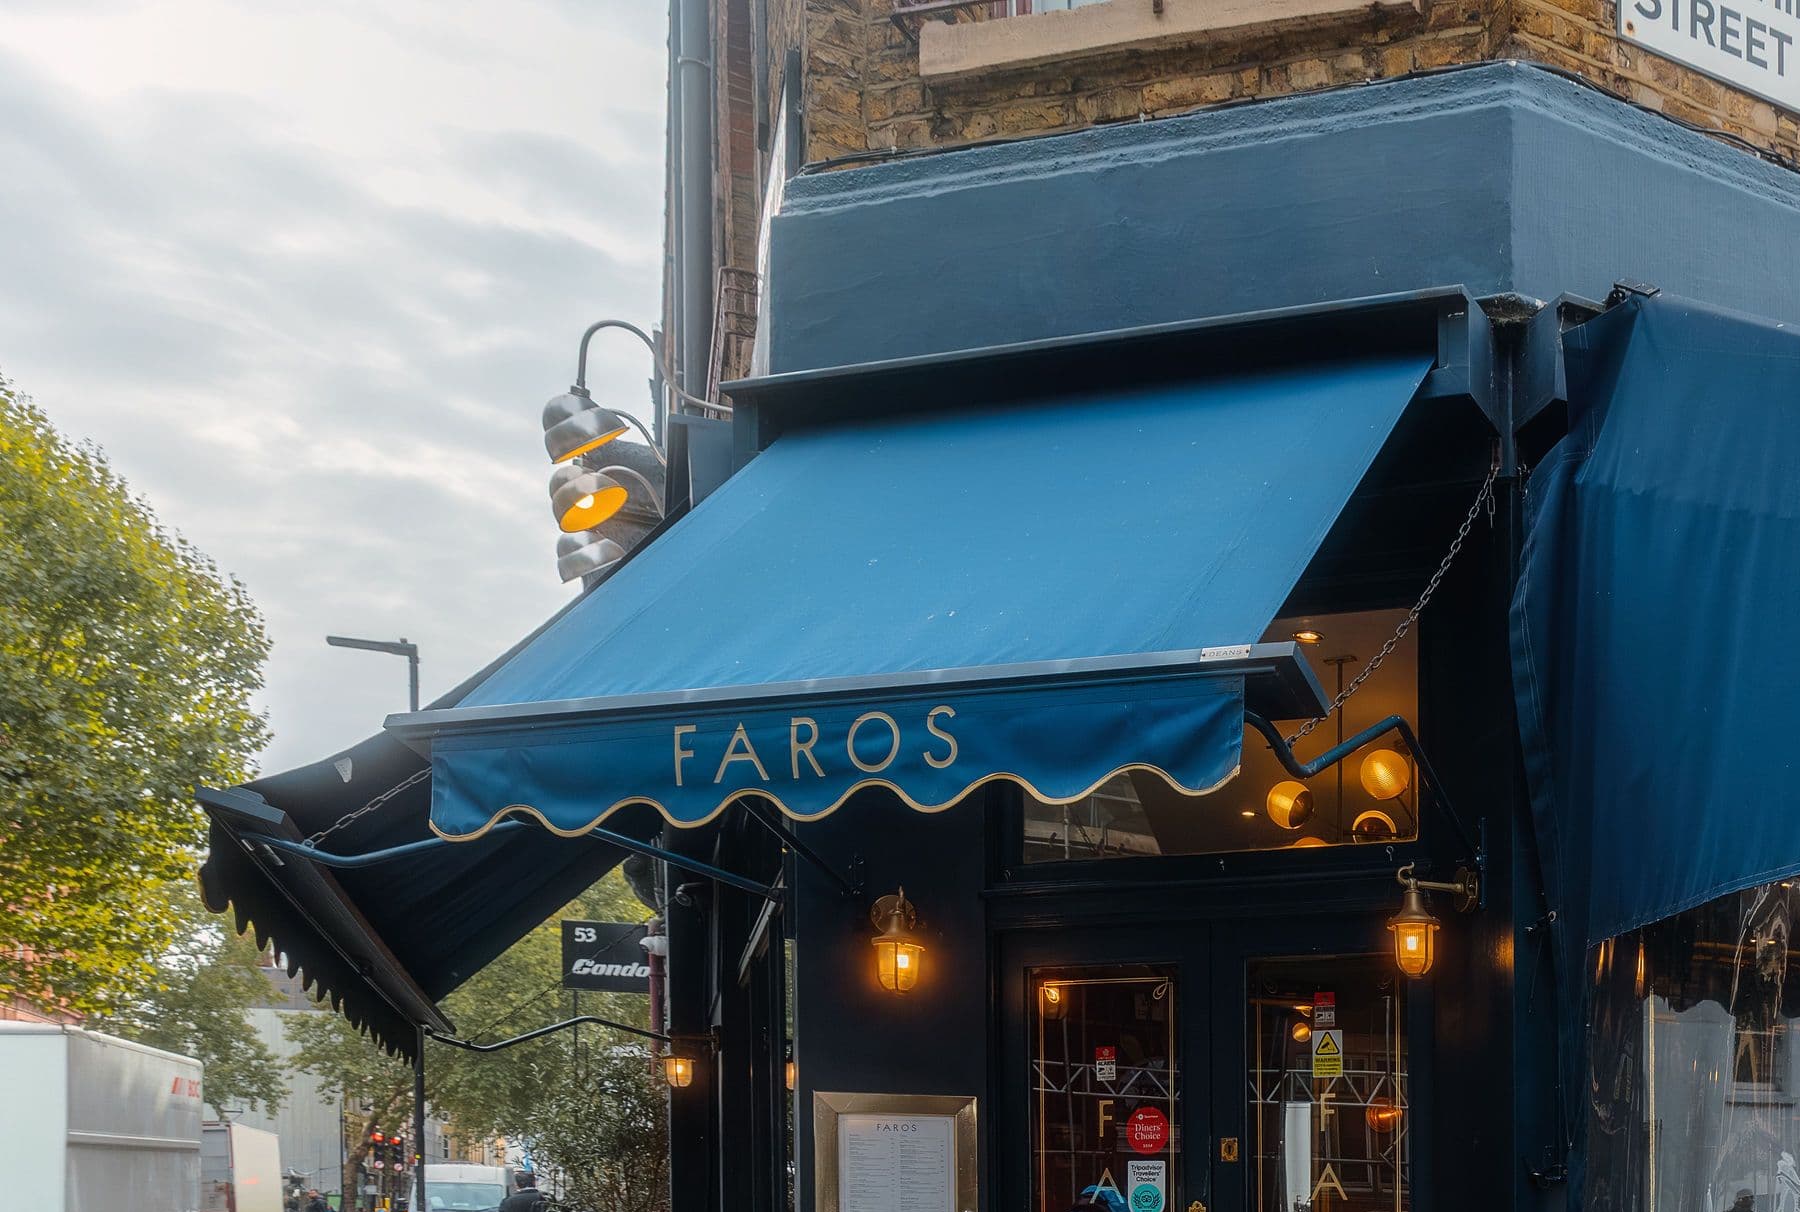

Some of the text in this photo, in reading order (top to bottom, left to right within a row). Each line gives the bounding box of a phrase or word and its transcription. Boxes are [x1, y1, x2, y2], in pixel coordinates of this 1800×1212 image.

[674, 705, 959, 787] FAROS
[574, 927, 597, 942] 53
[572, 958, 651, 978] Condo
[876, 1123, 917, 1132] FAROS
[1134, 1131, 1161, 1140] Choice
